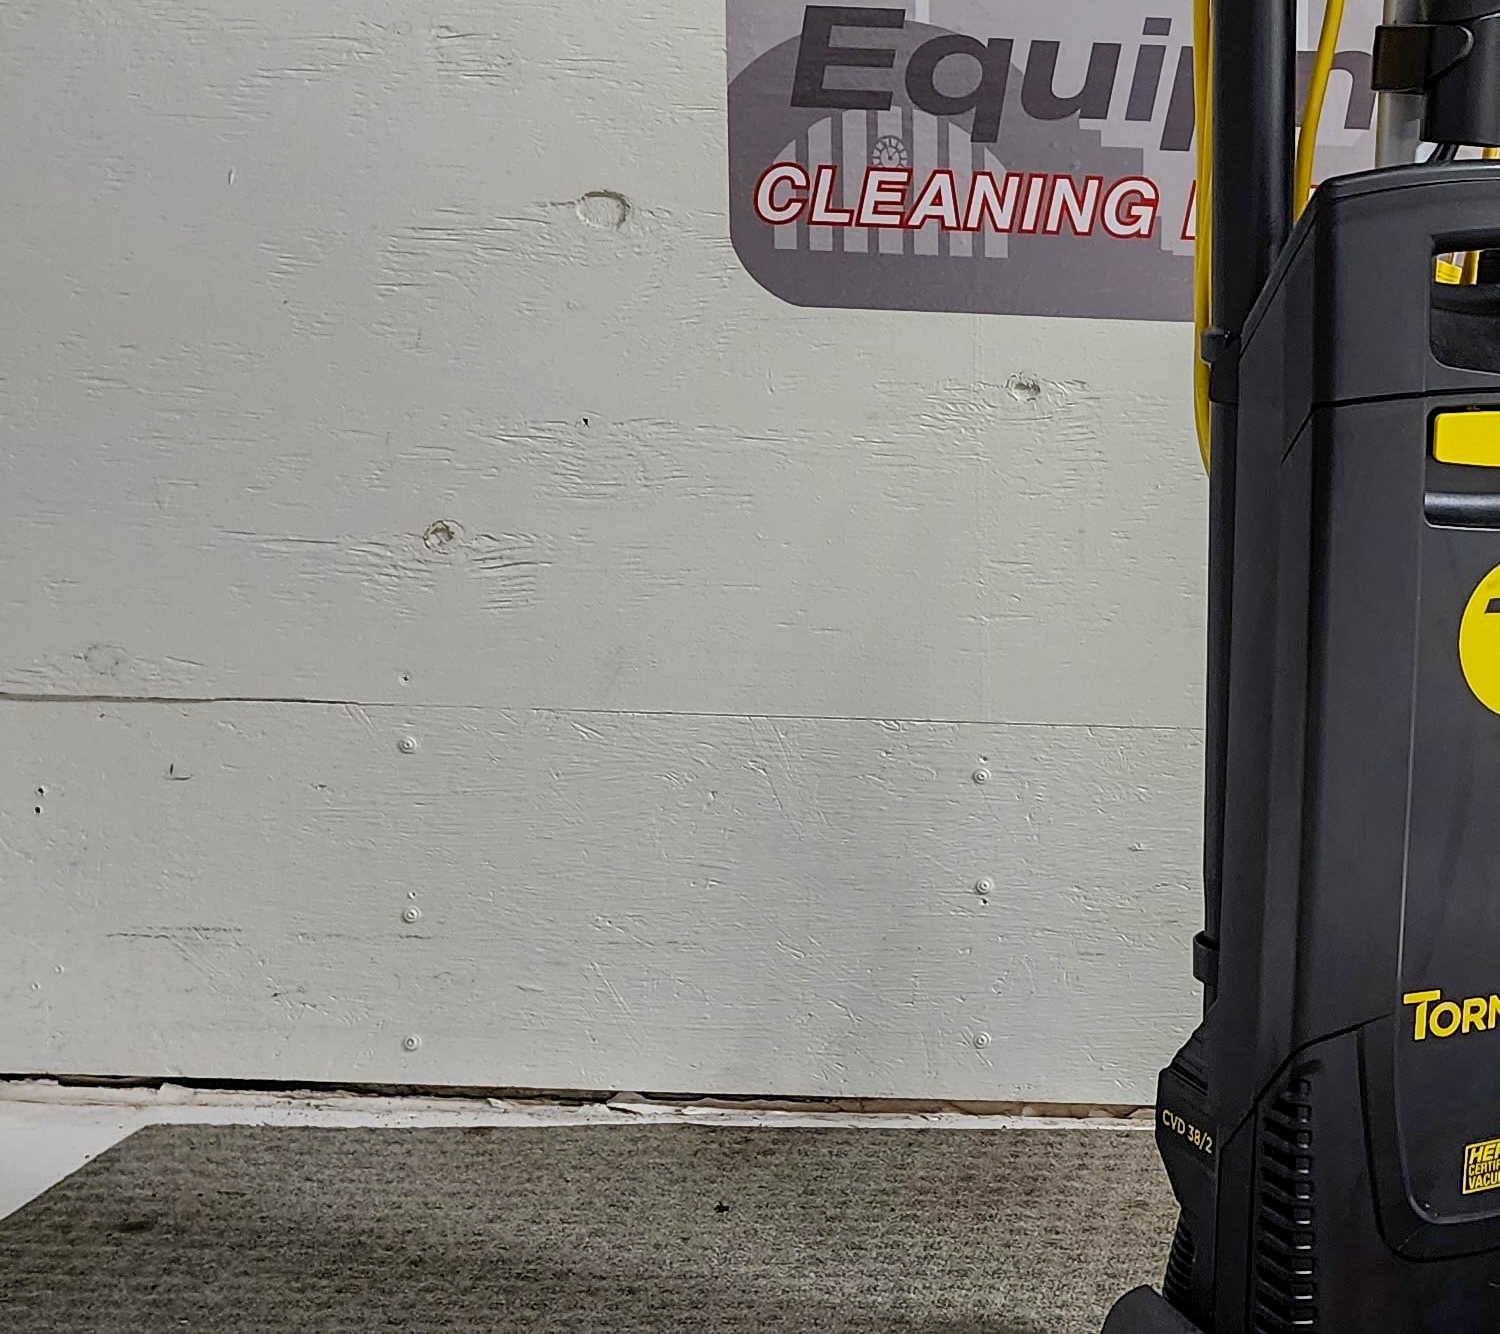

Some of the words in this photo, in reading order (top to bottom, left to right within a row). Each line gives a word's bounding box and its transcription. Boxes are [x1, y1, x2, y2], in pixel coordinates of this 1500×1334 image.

[753, 162, 1160, 239] CLEANING
[1162, 1108, 1186, 1135] CVD
[1187, 1123, 1213, 1154] 38/2
